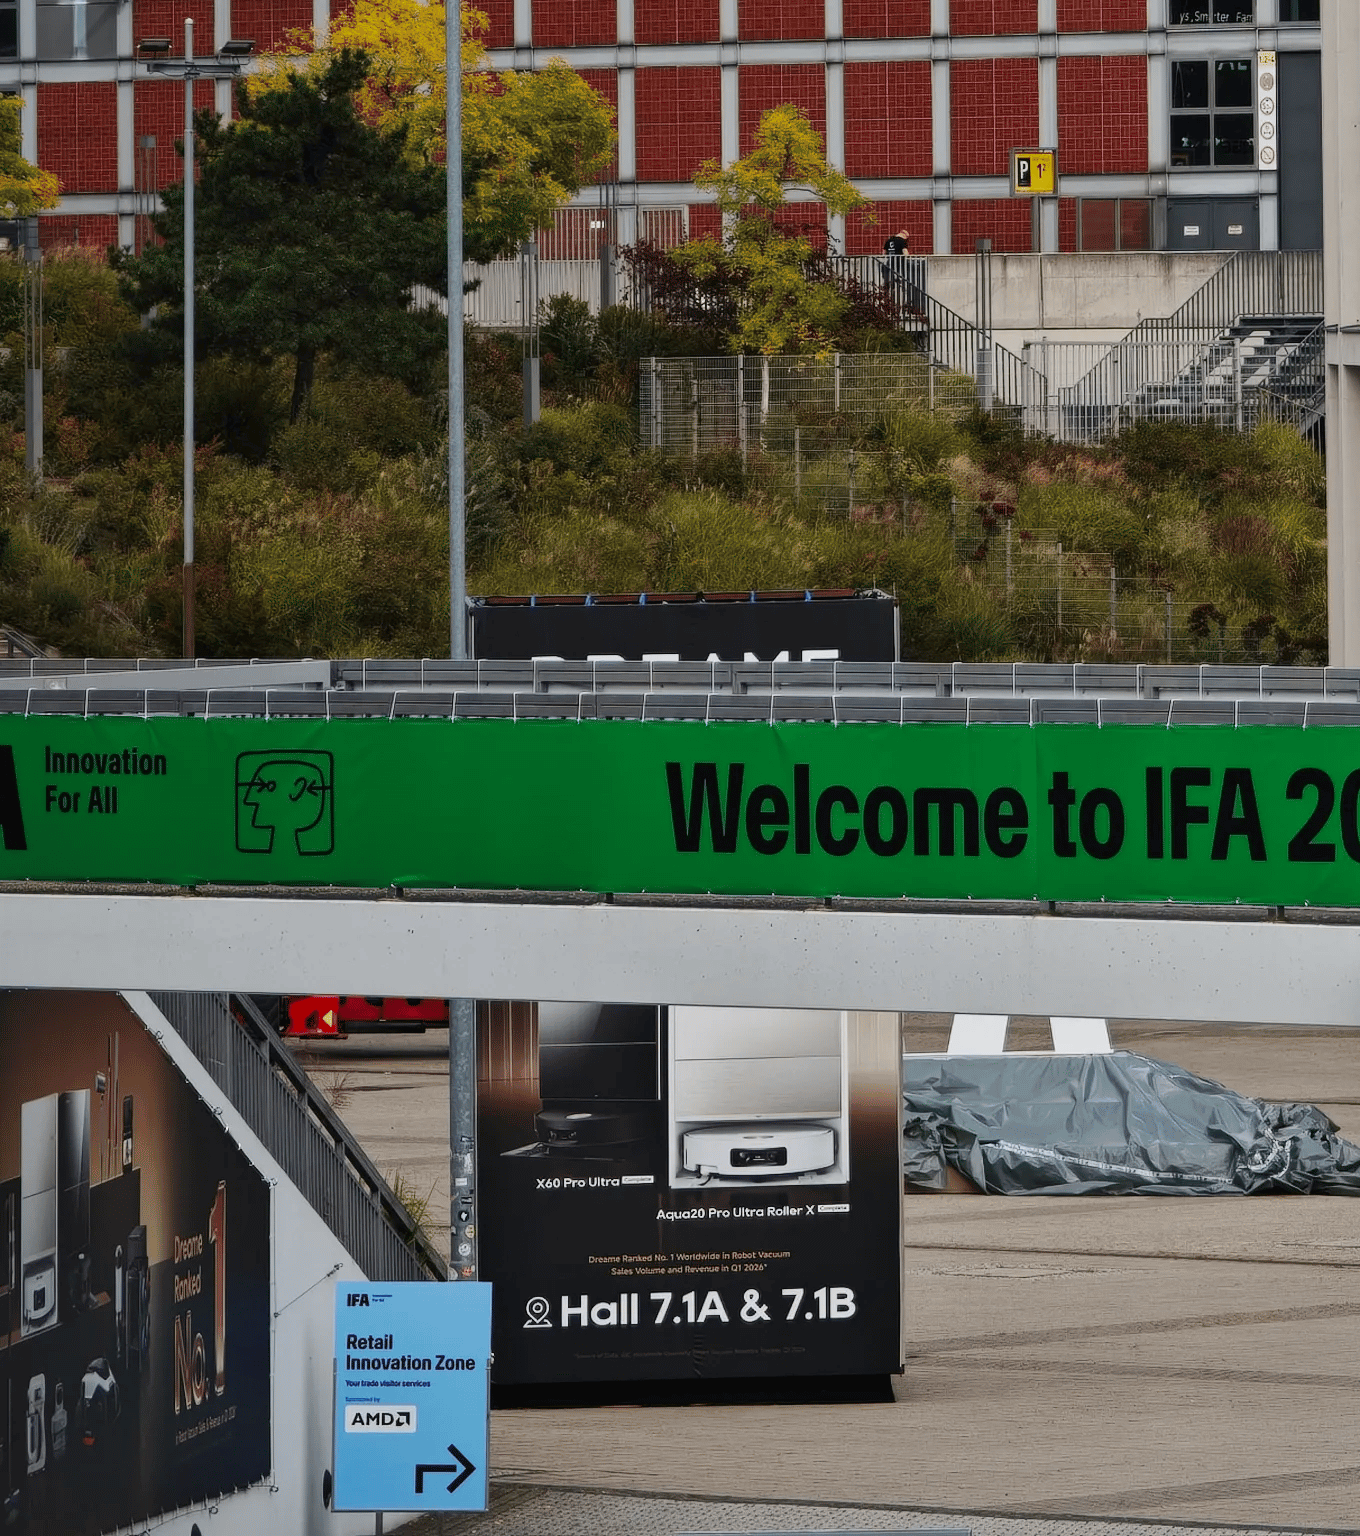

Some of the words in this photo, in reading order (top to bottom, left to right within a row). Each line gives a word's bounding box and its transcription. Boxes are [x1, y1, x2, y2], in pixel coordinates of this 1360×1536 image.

[1019, 160, 1029, 180] P
[45, 746, 167, 776] Innovation
[46, 785, 80, 813] For
[88, 785, 118, 814] All
[665, 761, 1028, 859] Welcome
[1048, 771, 1126, 860] to
[1146, 765, 1268, 861] IFA
[536, 1178, 560, 1189] X60
[564, 1178, 586, 1189] Pro
[588, 1176, 620, 1188] Ultra
[656, 1208, 706, 1221] Aqua20
[708, 1207, 731, 1219] Pro
[733, 1206, 764, 1218] Ultra
[767, 1205, 803, 1217] Roller
[805, 1204, 815, 1215] X
[174, 1234, 203, 1264] Dreame
[588, 1254, 620, 1263] Dreame
[622, 1253, 653, 1263] Ranked
[675, 1251, 721, 1262] Worldwide
[722, 1251, 730, 1259] in
[732, 1250, 756, 1260] Robot
[757, 1250, 791, 1259] Vacuum
[611, 1267, 633, 1276] Sales
[635, 1266, 665, 1275] Volume
[667, 1265, 683, 1274] and
[685, 1265, 719, 1274] Revenue
[721, 1265, 729, 1273] in
[731, 1264, 742, 1273] Q1
[175, 1266, 202, 1303] Ranked
[346, 1293, 370, 1307] IFA
[560, 1293, 639, 1328] Hall
[650, 1290, 730, 1325] 7.1A
[739, 1288, 771, 1323] &
[781, 1286, 857, 1321] 7.1B
[346, 1334, 393, 1350] Retail
[346, 1354, 432, 1371] Innovation
[435, 1354, 476, 1371] Zone
[345, 1379, 360, 1387] Your
[361, 1379, 379, 1387] trade
[402, 1380, 431, 1388] services
[351, 1412, 395, 1426] AMD
